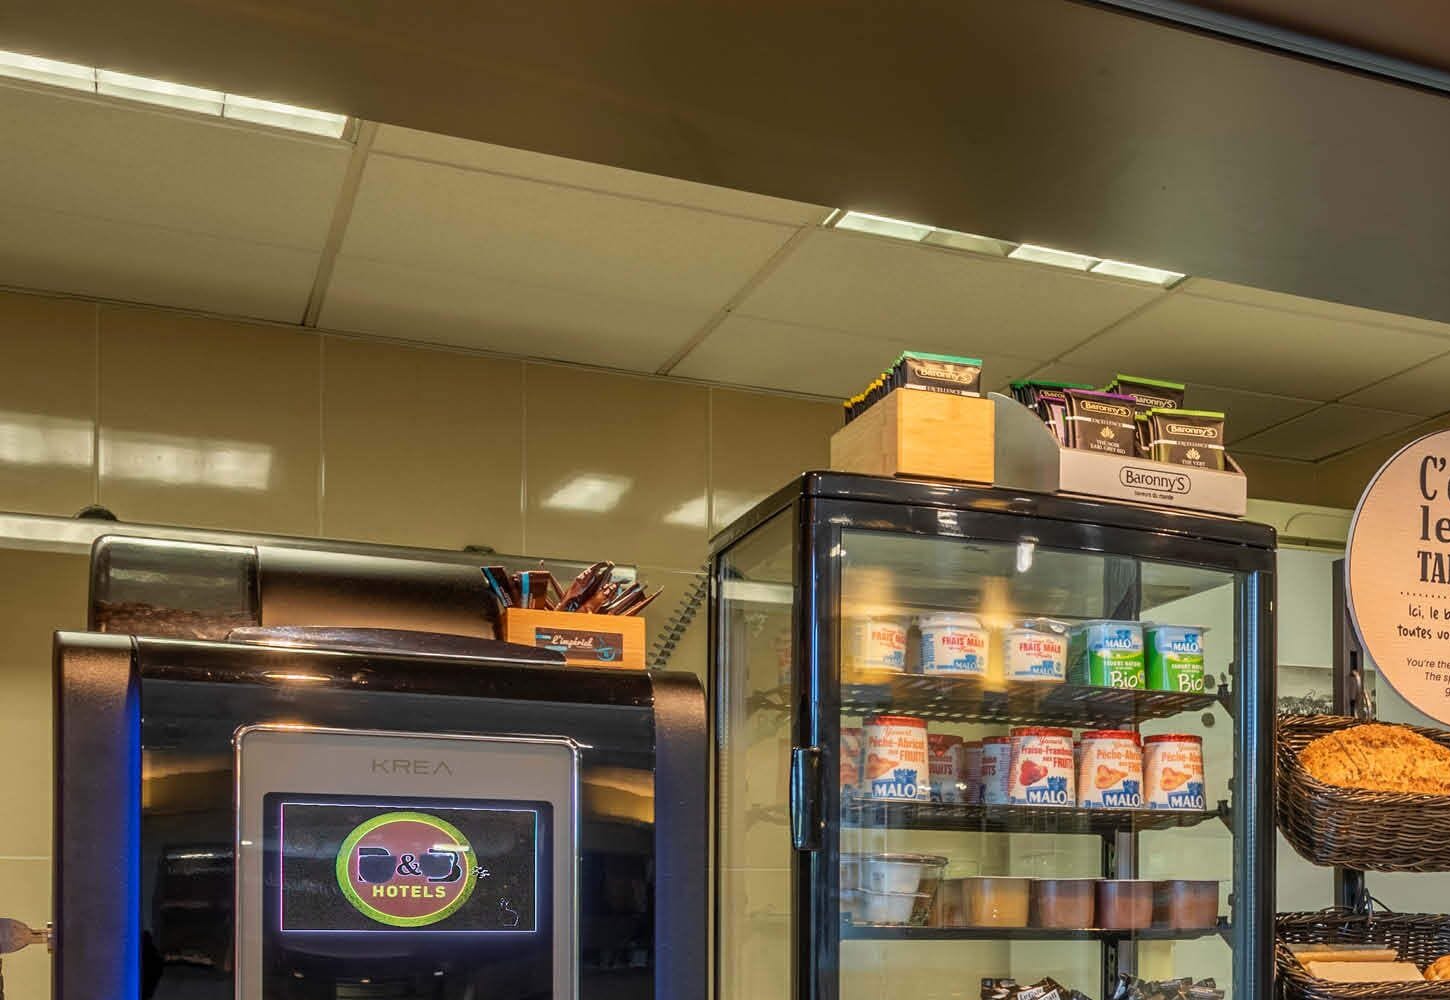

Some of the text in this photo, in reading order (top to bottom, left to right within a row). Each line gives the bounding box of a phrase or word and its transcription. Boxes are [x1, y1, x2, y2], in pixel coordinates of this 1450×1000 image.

[1430, 606, 1439, 619] le
[1397, 624, 1432, 639] toutes
[1104, 639, 1131, 649] MALO
[1173, 641, 1199, 652] MALO
[1407, 657, 1435, 669] You're
[1110, 670, 1138, 688] Bio
[1177, 673, 1204, 692] Bio
[1424, 672, 1441, 682] The
[371, 759, 453, 776] KREA
[874, 783, 917, 798] MALO
[1028, 790, 1067, 805] MALO
[1104, 793, 1140, 808] MALO
[1170, 794, 1204, 809] MALO
[371, 885, 447, 899] HOTELS
